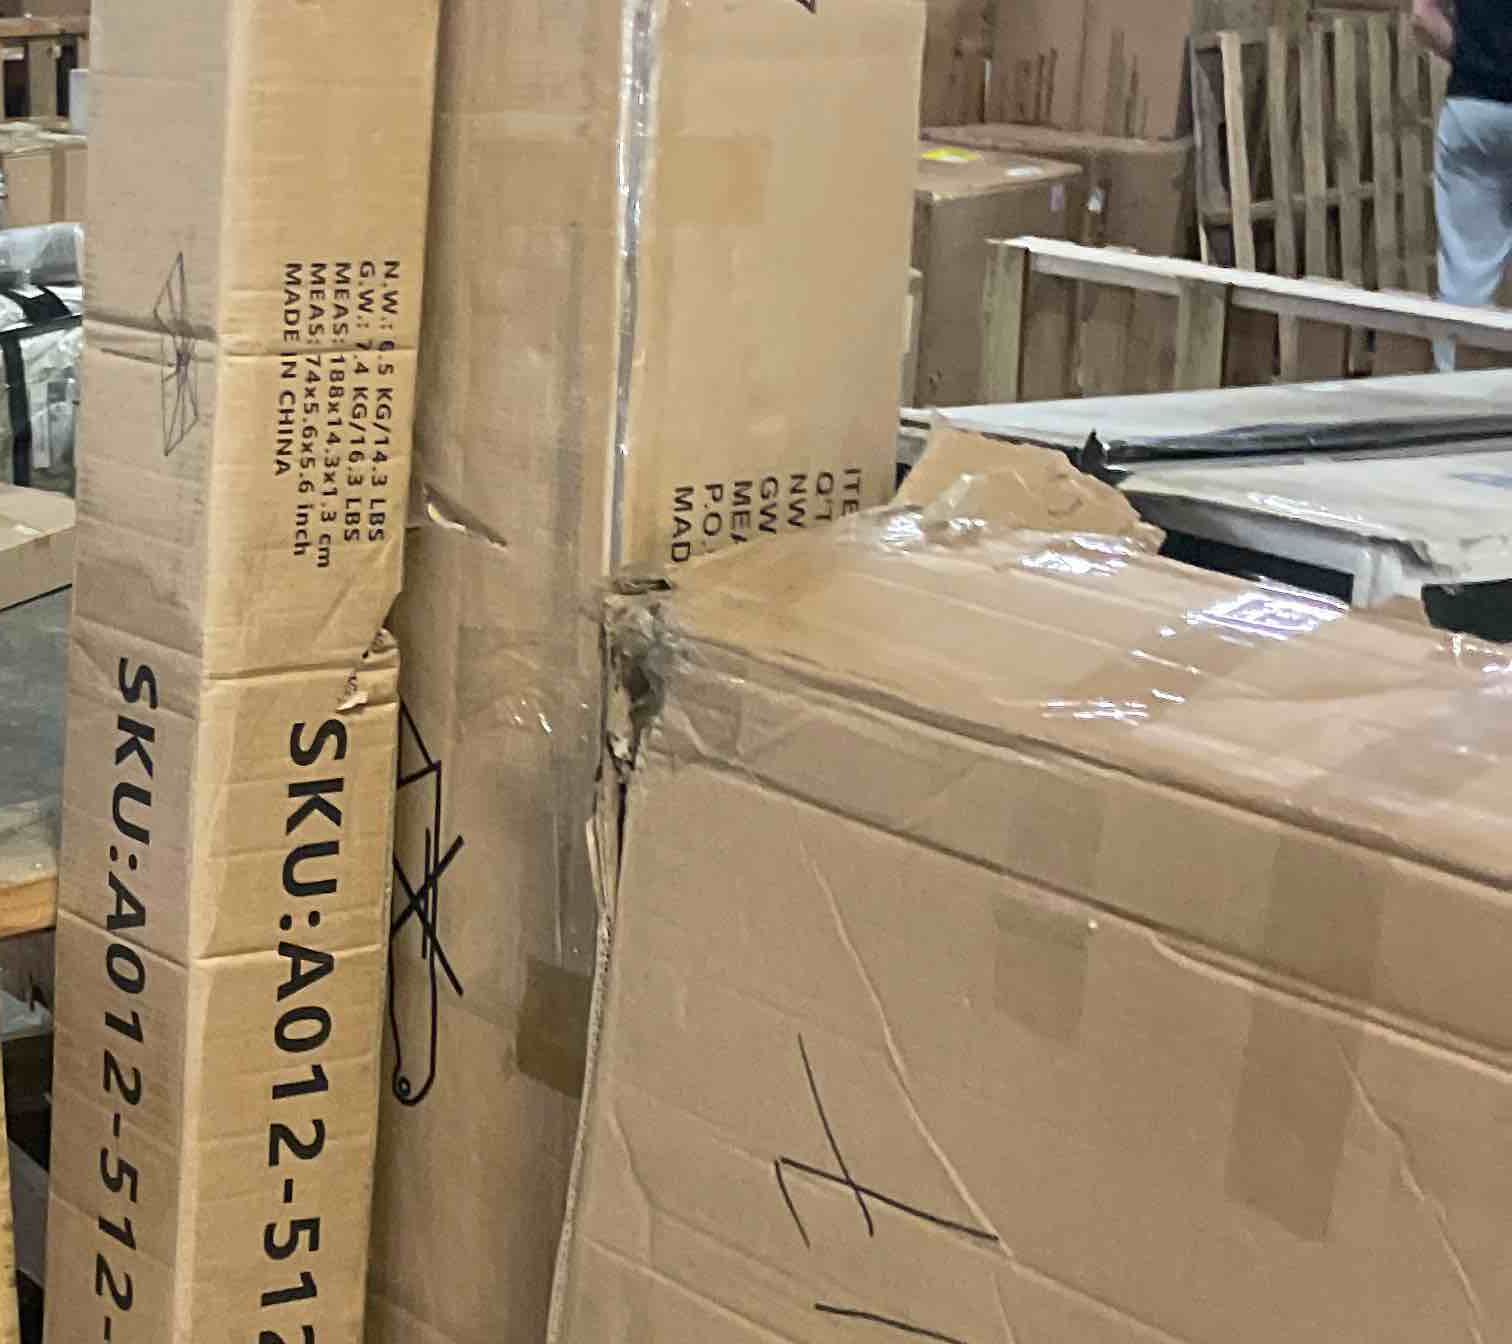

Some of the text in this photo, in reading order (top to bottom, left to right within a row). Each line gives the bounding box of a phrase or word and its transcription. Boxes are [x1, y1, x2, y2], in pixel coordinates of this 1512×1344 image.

[332, 262, 352, 344] MEAS:
[275, 262, 303, 476] MADE IN CHINA
[354, 339, 373, 375] 7.4
[293, 262, 328, 556] MEAS: 74x5.6x5.6 inch
[346, 386, 368, 486] KG/16.3
[371, 387, 393, 486] KG/14.3
[317, 533, 332, 568] cm
[343, 498, 361, 542] LBS
[368, 498, 387, 542] LBS
